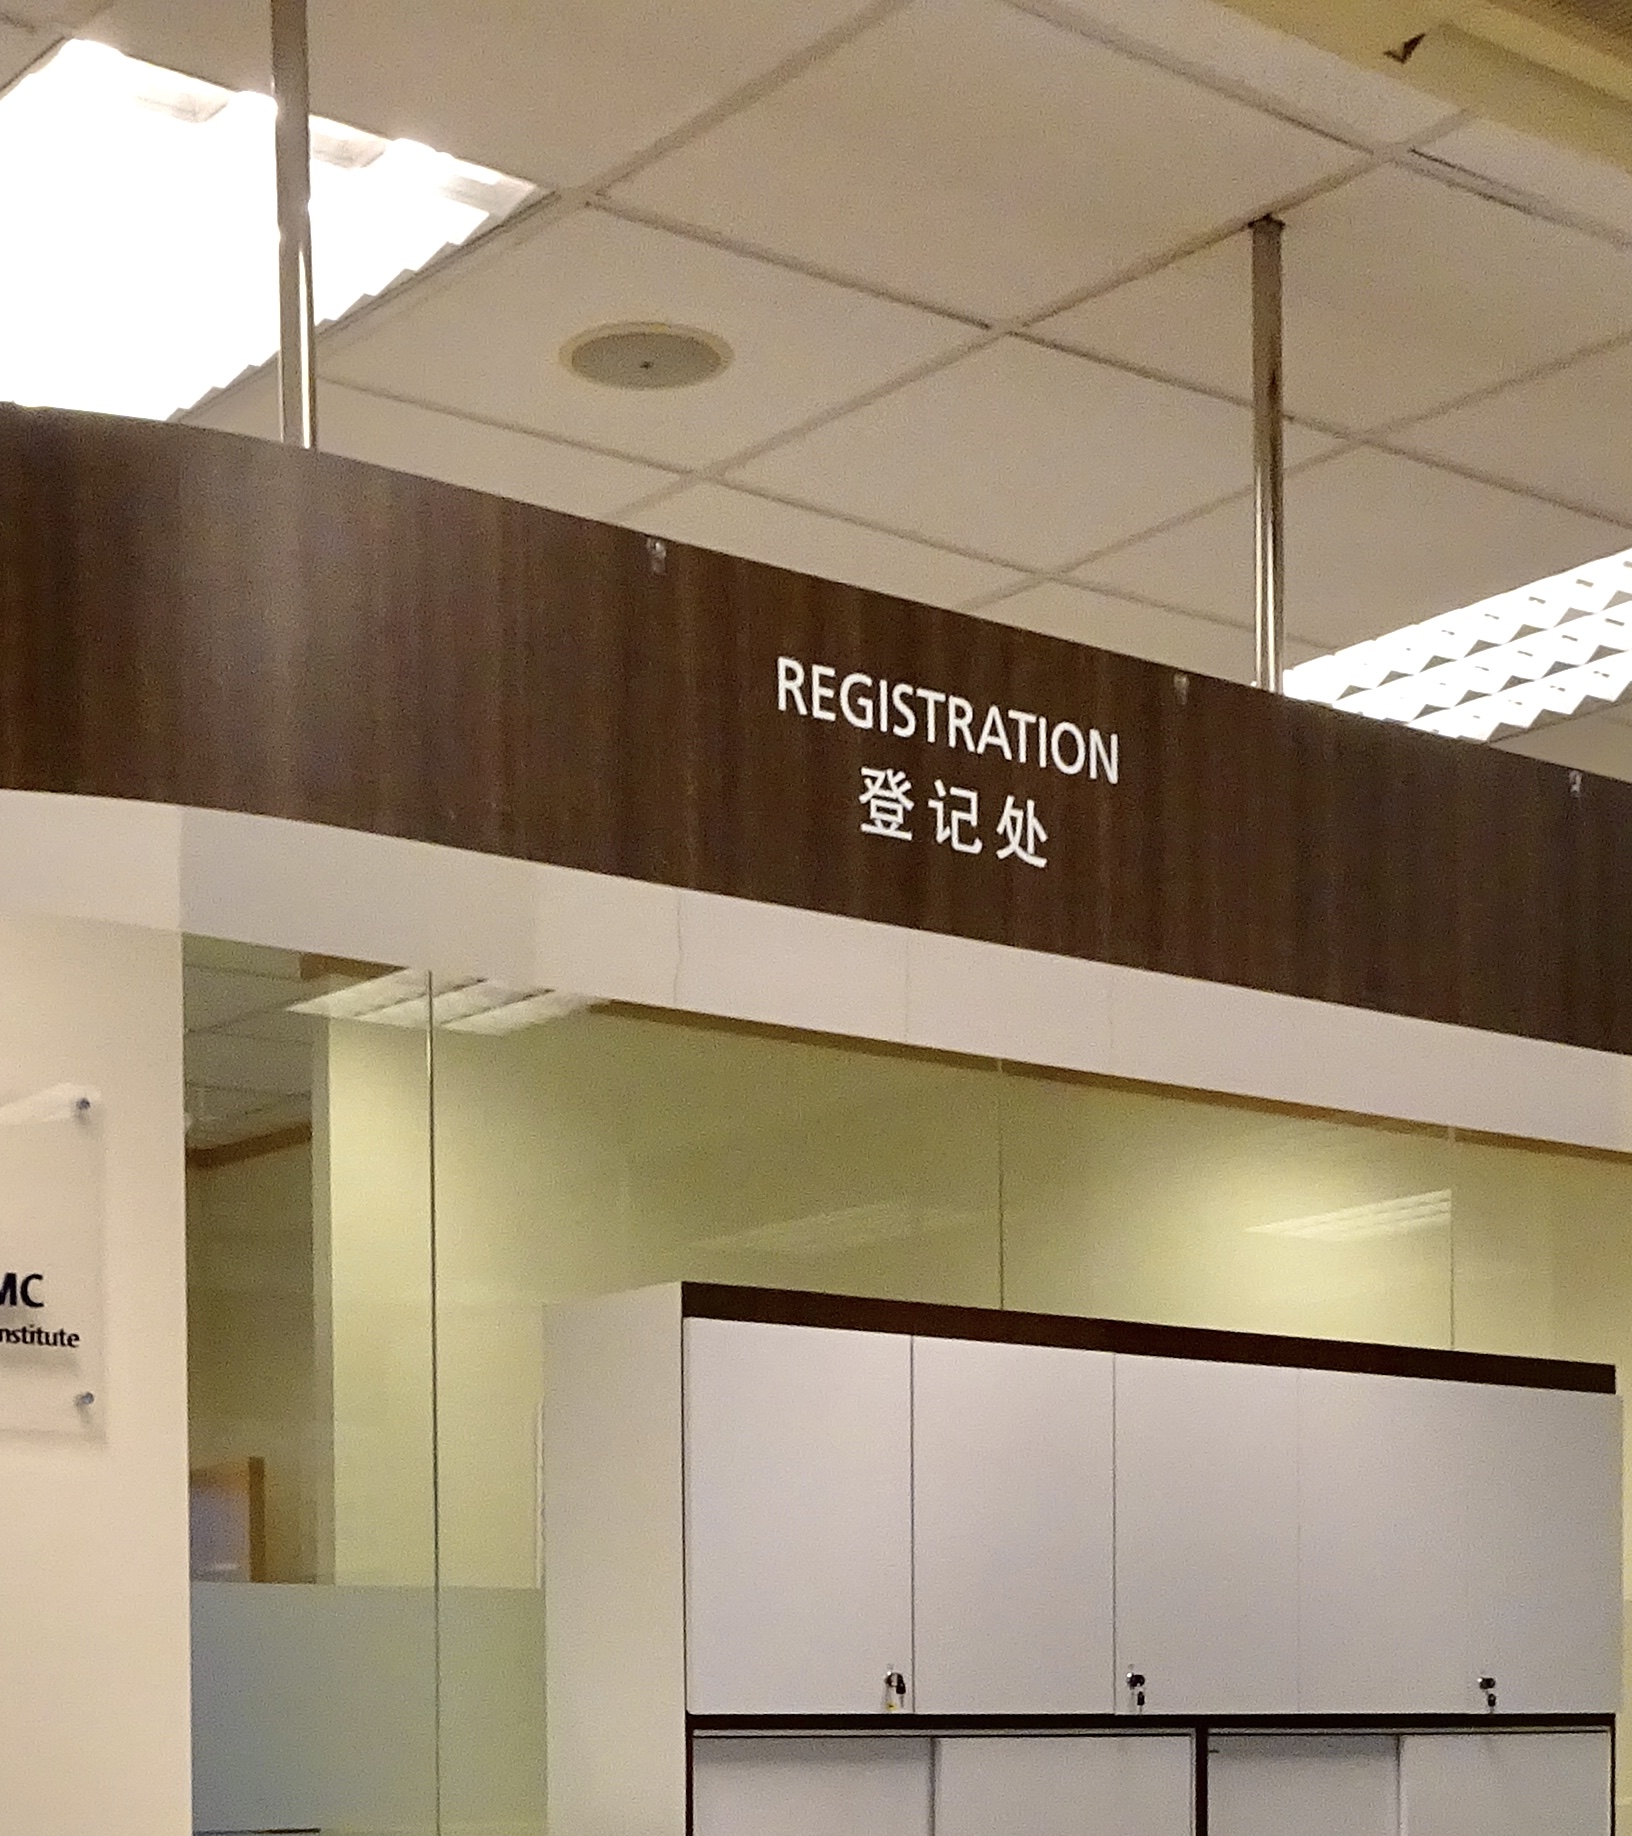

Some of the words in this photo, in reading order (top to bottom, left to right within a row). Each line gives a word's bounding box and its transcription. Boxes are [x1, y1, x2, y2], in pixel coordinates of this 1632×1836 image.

[778, 656, 1118, 785] REGISTRATION
[859, 766, 1049, 869] 登记处
